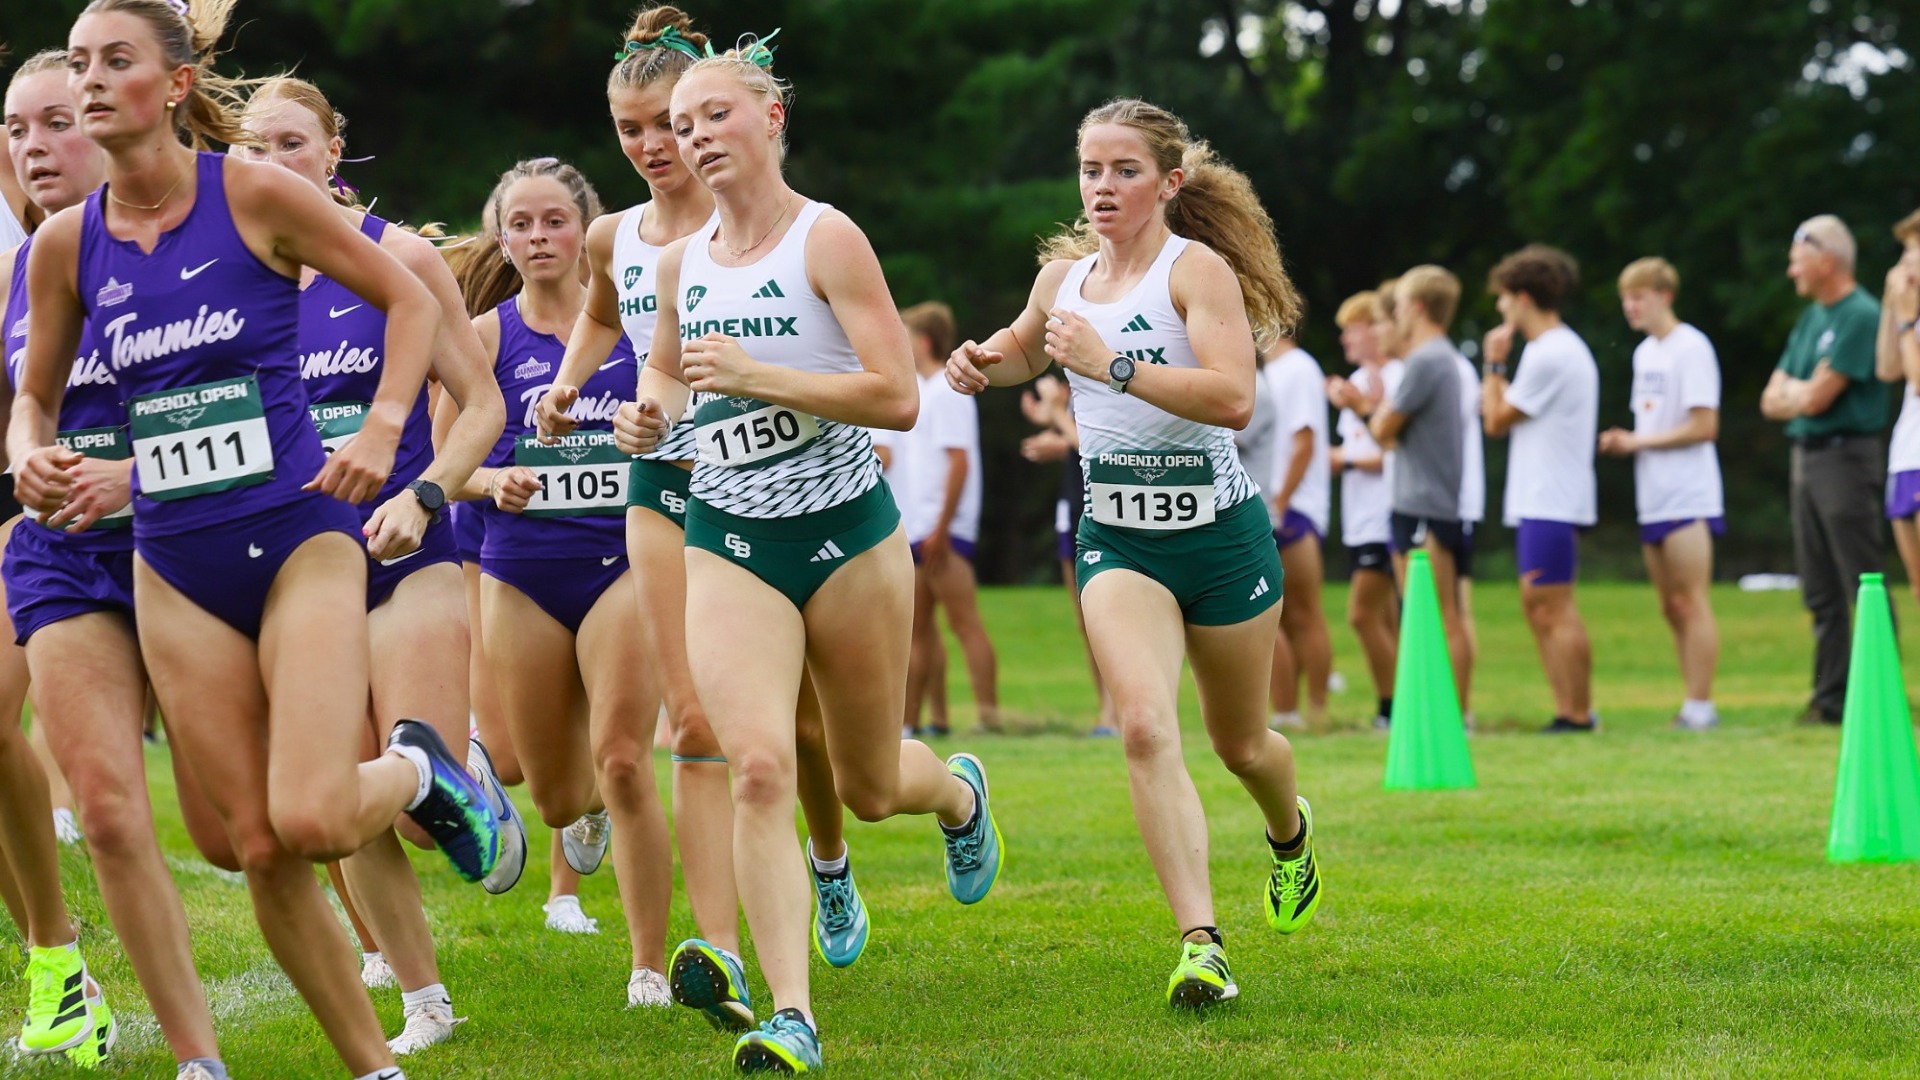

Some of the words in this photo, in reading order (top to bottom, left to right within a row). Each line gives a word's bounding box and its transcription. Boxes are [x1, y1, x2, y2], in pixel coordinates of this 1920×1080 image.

[104, 304, 246, 371] Tommies
[299, 339, 379, 380] mies
[136, 391, 199, 416] PHOENIX
[199, 383, 248, 404] OPEN
[322, 404, 362, 420] OPEN
[74, 433, 116, 449] OPEN
[588, 433, 616, 447] OPE
[711, 410, 800, 460] 1150
[151, 431, 245, 480] 1111
[1099, 453, 1163, 467] PHOENIX
[1165, 455, 1204, 467] OPEN
[538, 470, 620, 501] 1105
[1109, 491, 1198, 522] 1139
